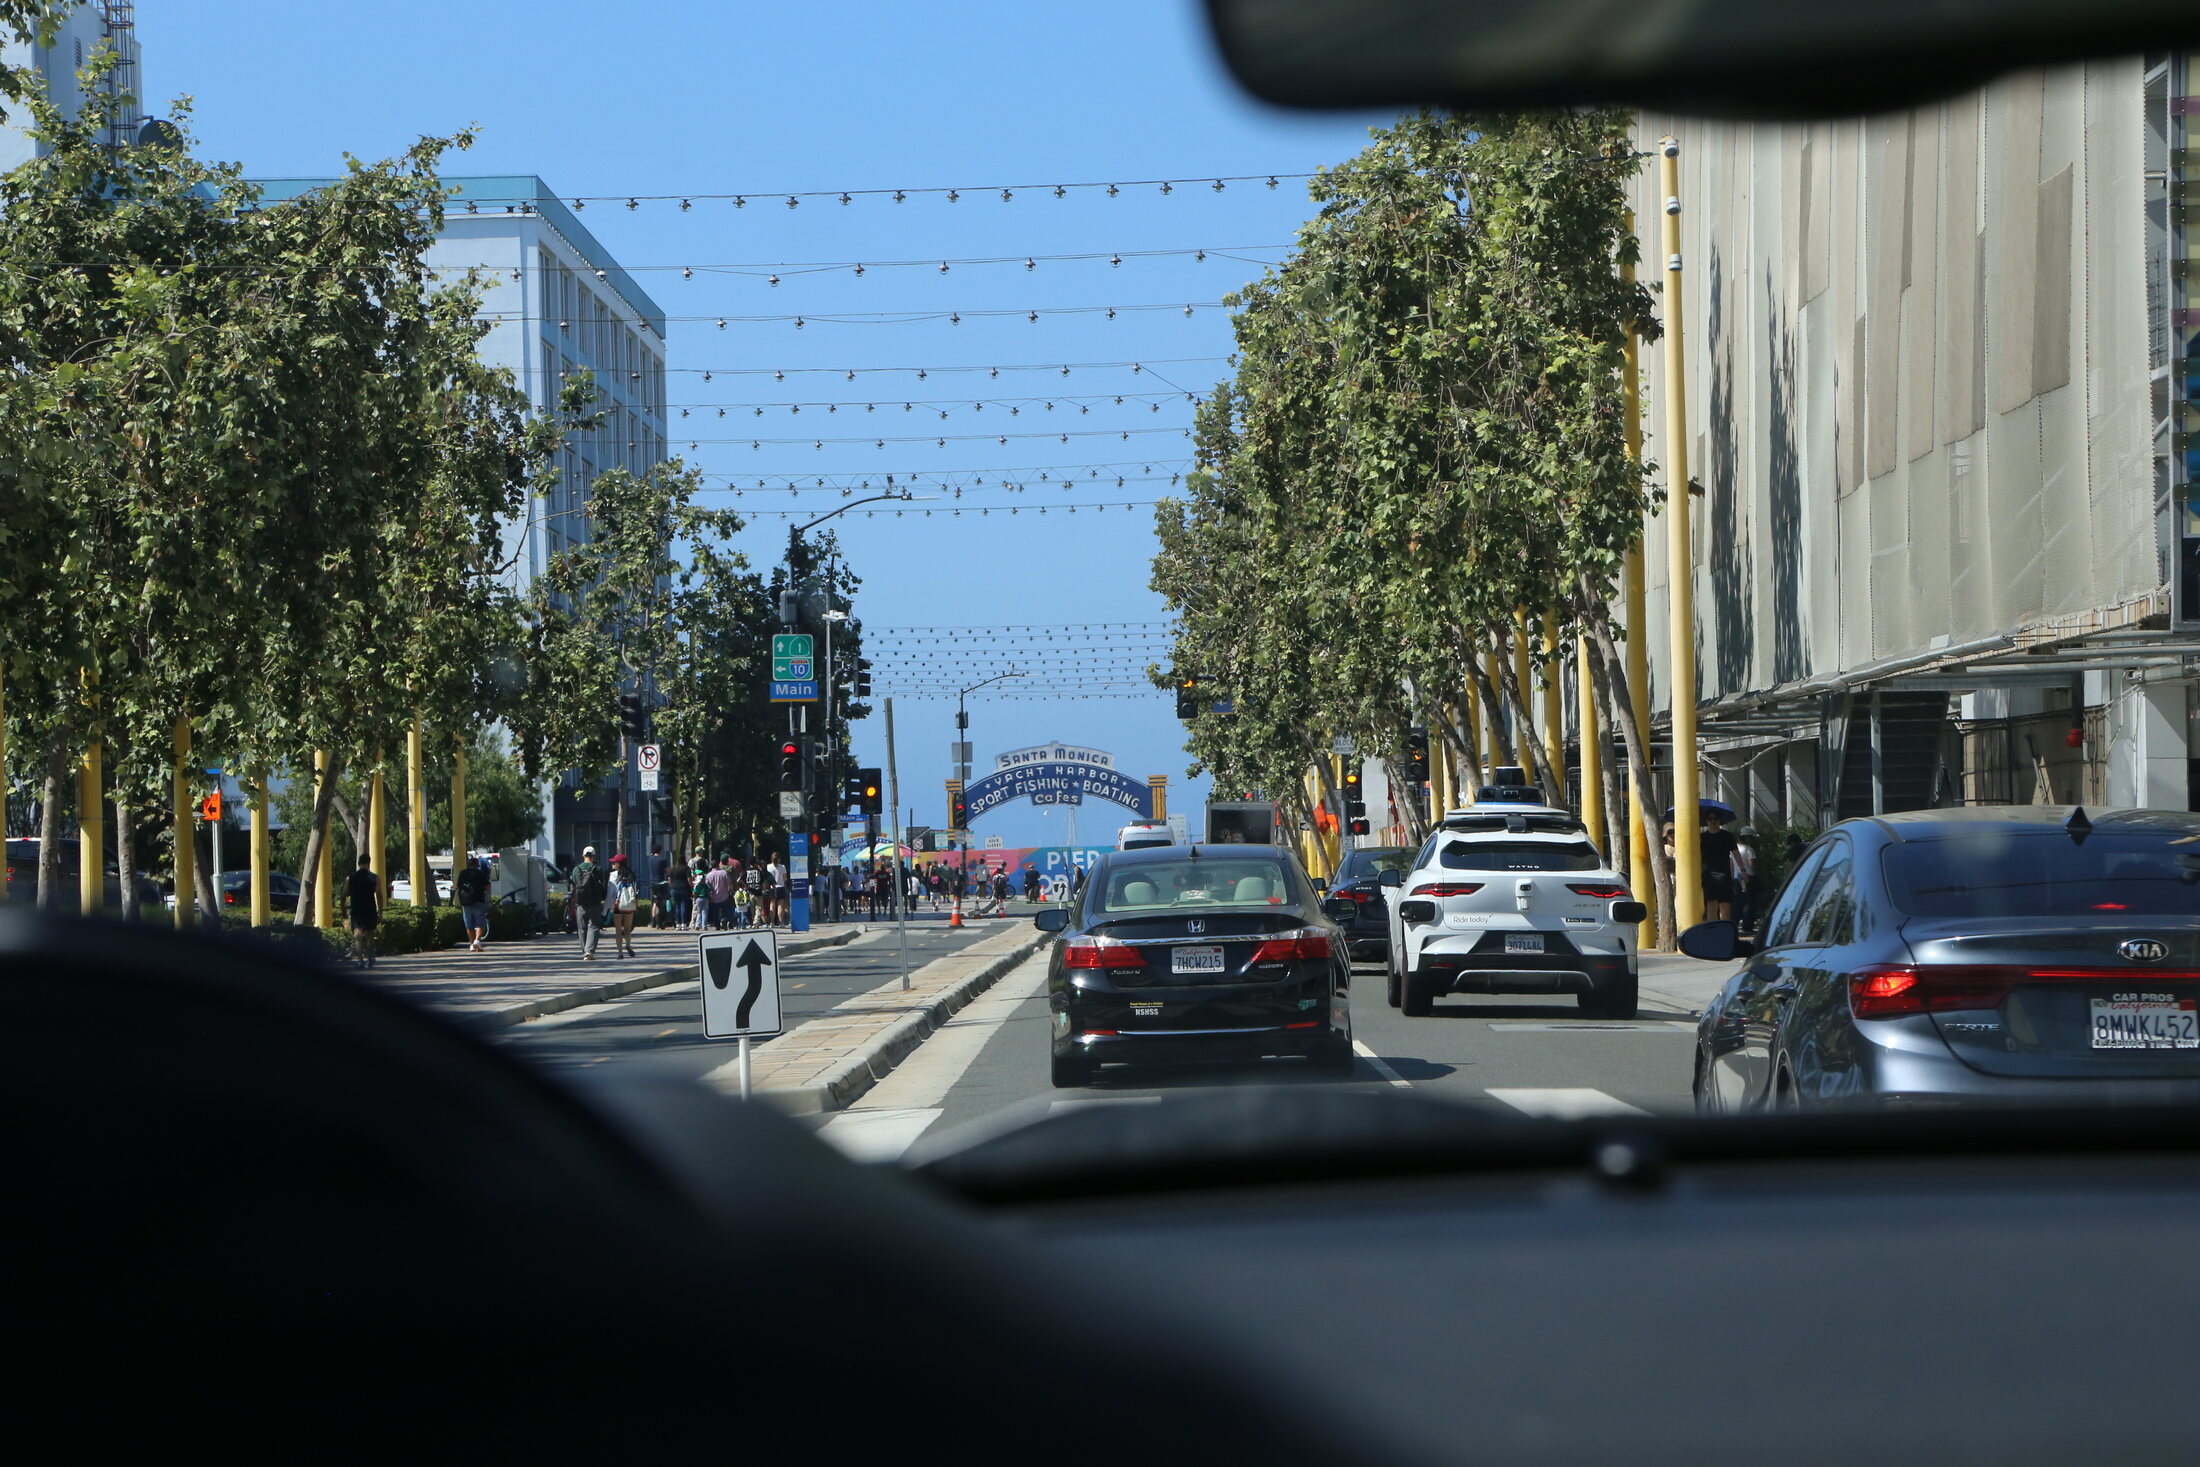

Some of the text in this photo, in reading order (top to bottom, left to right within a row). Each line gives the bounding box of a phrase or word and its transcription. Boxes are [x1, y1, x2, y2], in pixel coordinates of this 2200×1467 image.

[798, 643, 801, 653] 1
[793, 664, 806, 675] 10
[775, 683, 812, 695] Main
[1000, 748, 1109, 767] SANTA MONICA
[994, 766, 1119, 785] YACHT HARBOR
[970, 777, 1141, 814] SPORT FISHING BOATING
[1469, 916, 1489, 924] today
[2129, 943, 2162, 957] KIA
[1175, 955, 1221, 970] 7HCW215
[2112, 993, 2175, 1002] CAR PROS
[1135, 1008, 1159, 1016] NSHSS
[2111, 1002, 2175, 1013] California
[2096, 1014, 2194, 1040] 8MWK452
